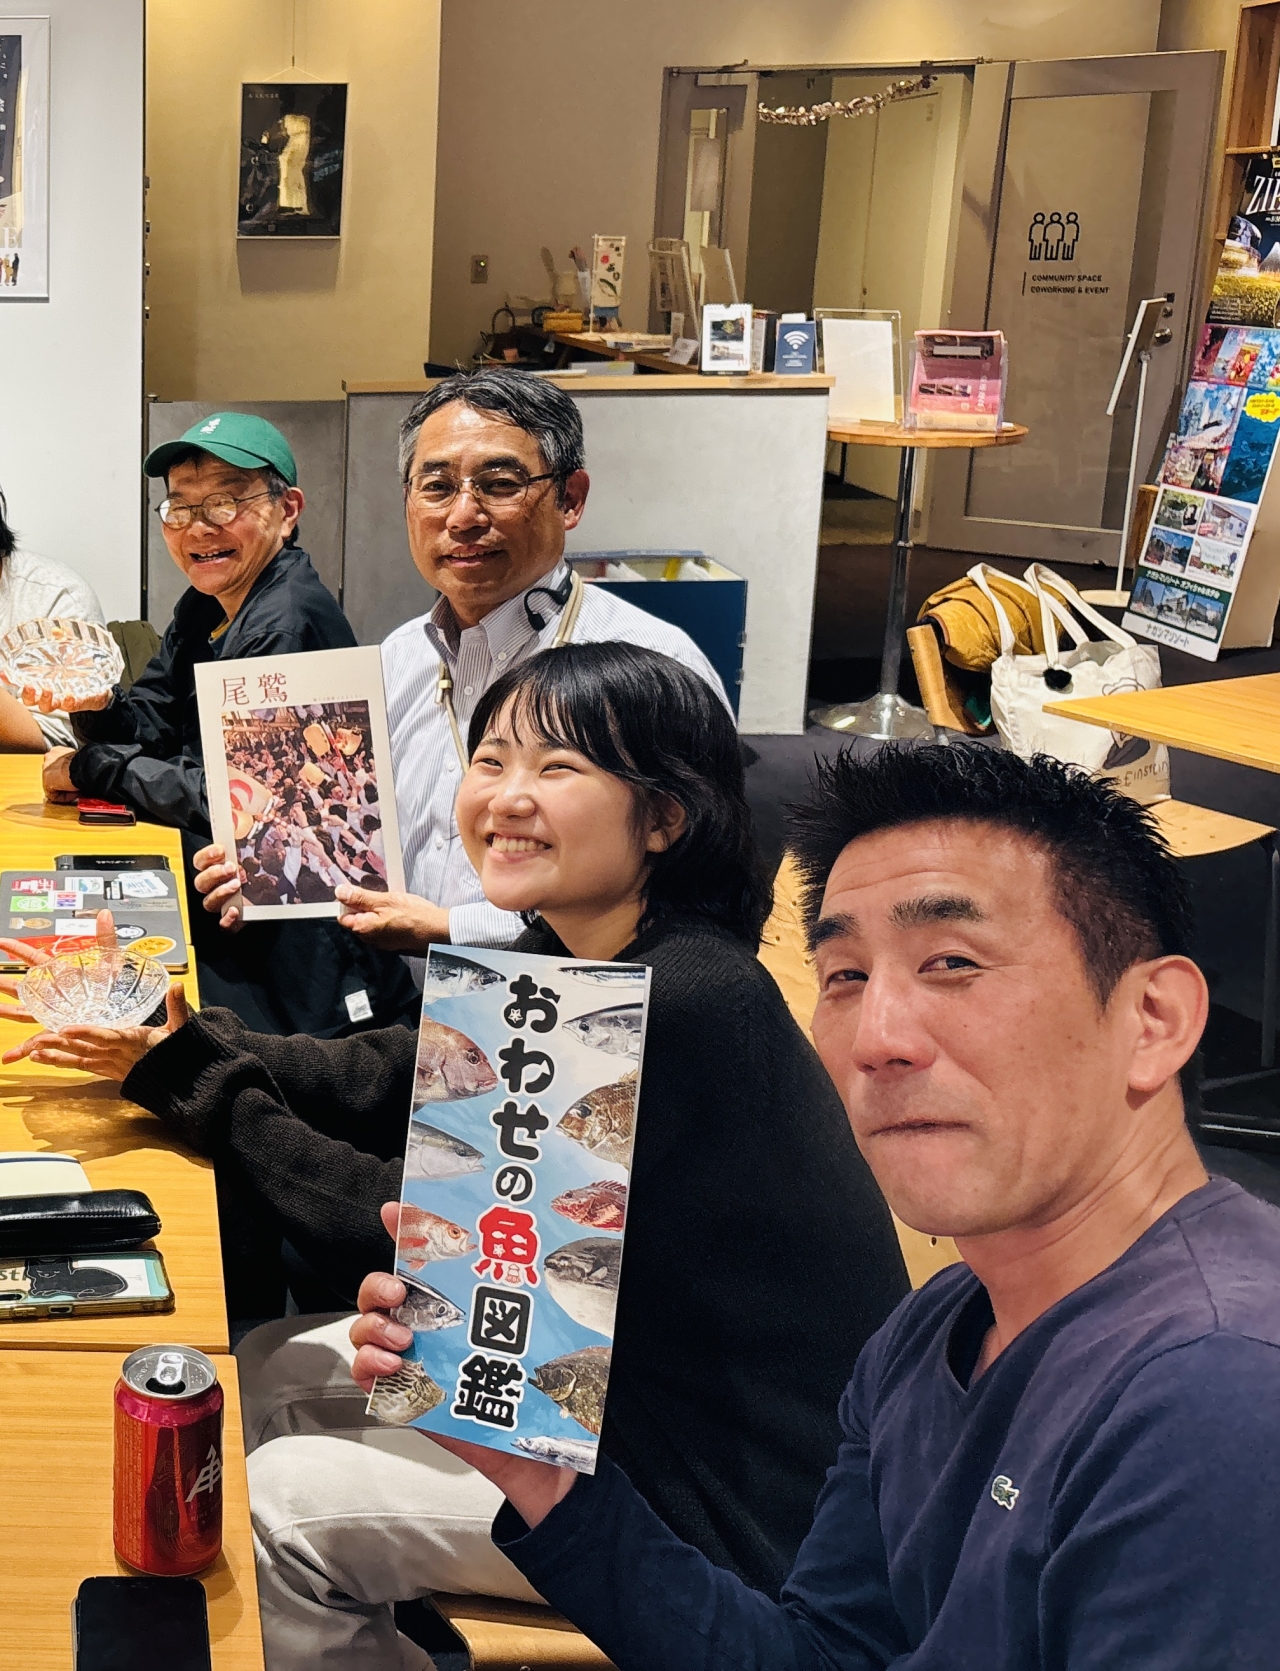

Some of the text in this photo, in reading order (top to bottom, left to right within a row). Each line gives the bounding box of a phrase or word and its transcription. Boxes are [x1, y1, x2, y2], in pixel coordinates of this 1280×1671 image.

[1031, 274, 1102, 282] COMMUNITY SPACE
[1030, 286, 1076, 294] COWORKING
[1084, 286, 1110, 294] EVENT
[221, 672, 288, 707] 尾鷲
[453, 972, 562, 1430] おわせの魚図鑑
